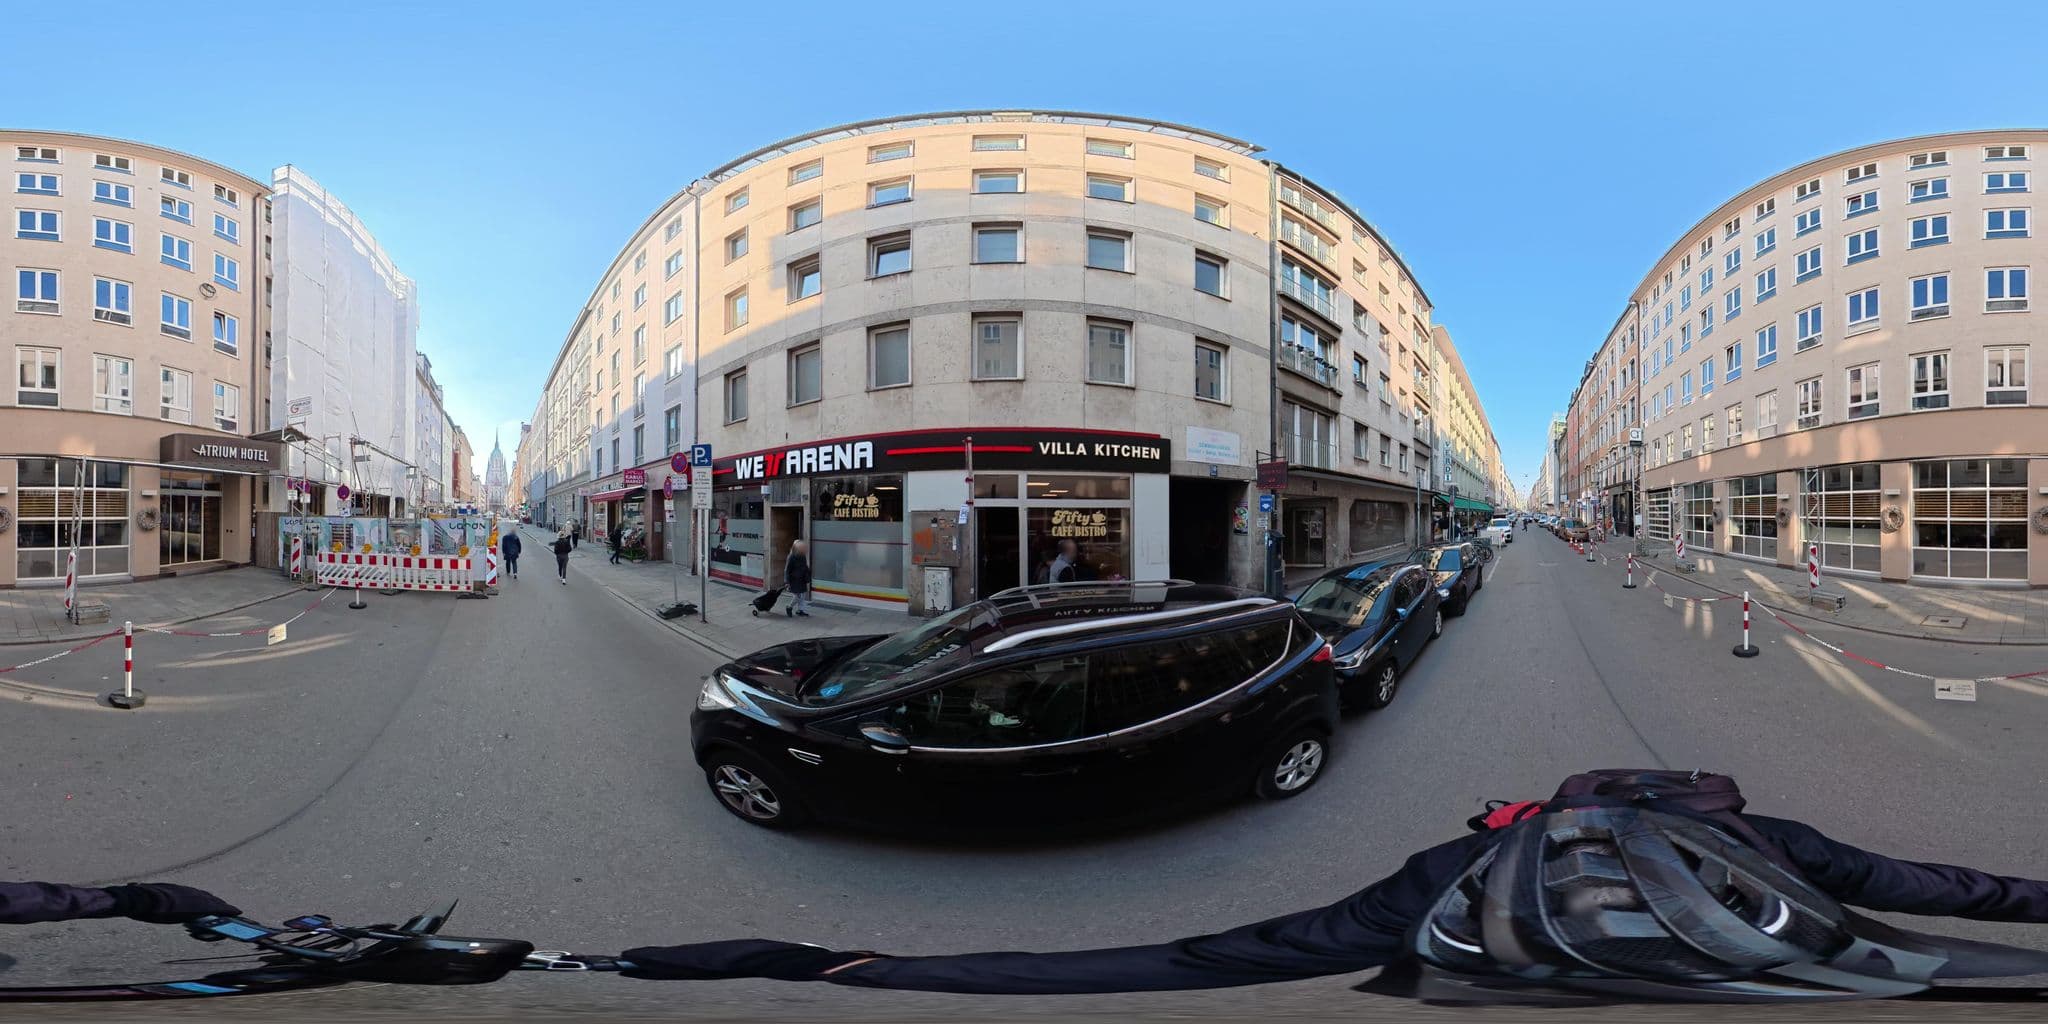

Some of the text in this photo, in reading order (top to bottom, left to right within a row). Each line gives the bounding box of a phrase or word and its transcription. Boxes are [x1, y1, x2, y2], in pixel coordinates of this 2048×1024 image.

[199, 444, 269, 462] ATRIUM HOTEL
[694, 447, 706, 465] P
[1039, 442, 1160, 460] VILLA KITCHEN
[736, 441, 873, 480] WETT ARENA
[1444, 441, 1452, 480] VERDI
[834, 494, 865, 507] Fifty
[851, 507, 879, 518] BISTRO
[1052, 510, 1090, 526] Fifty
[1075, 526, 1107, 537] BISTRO
